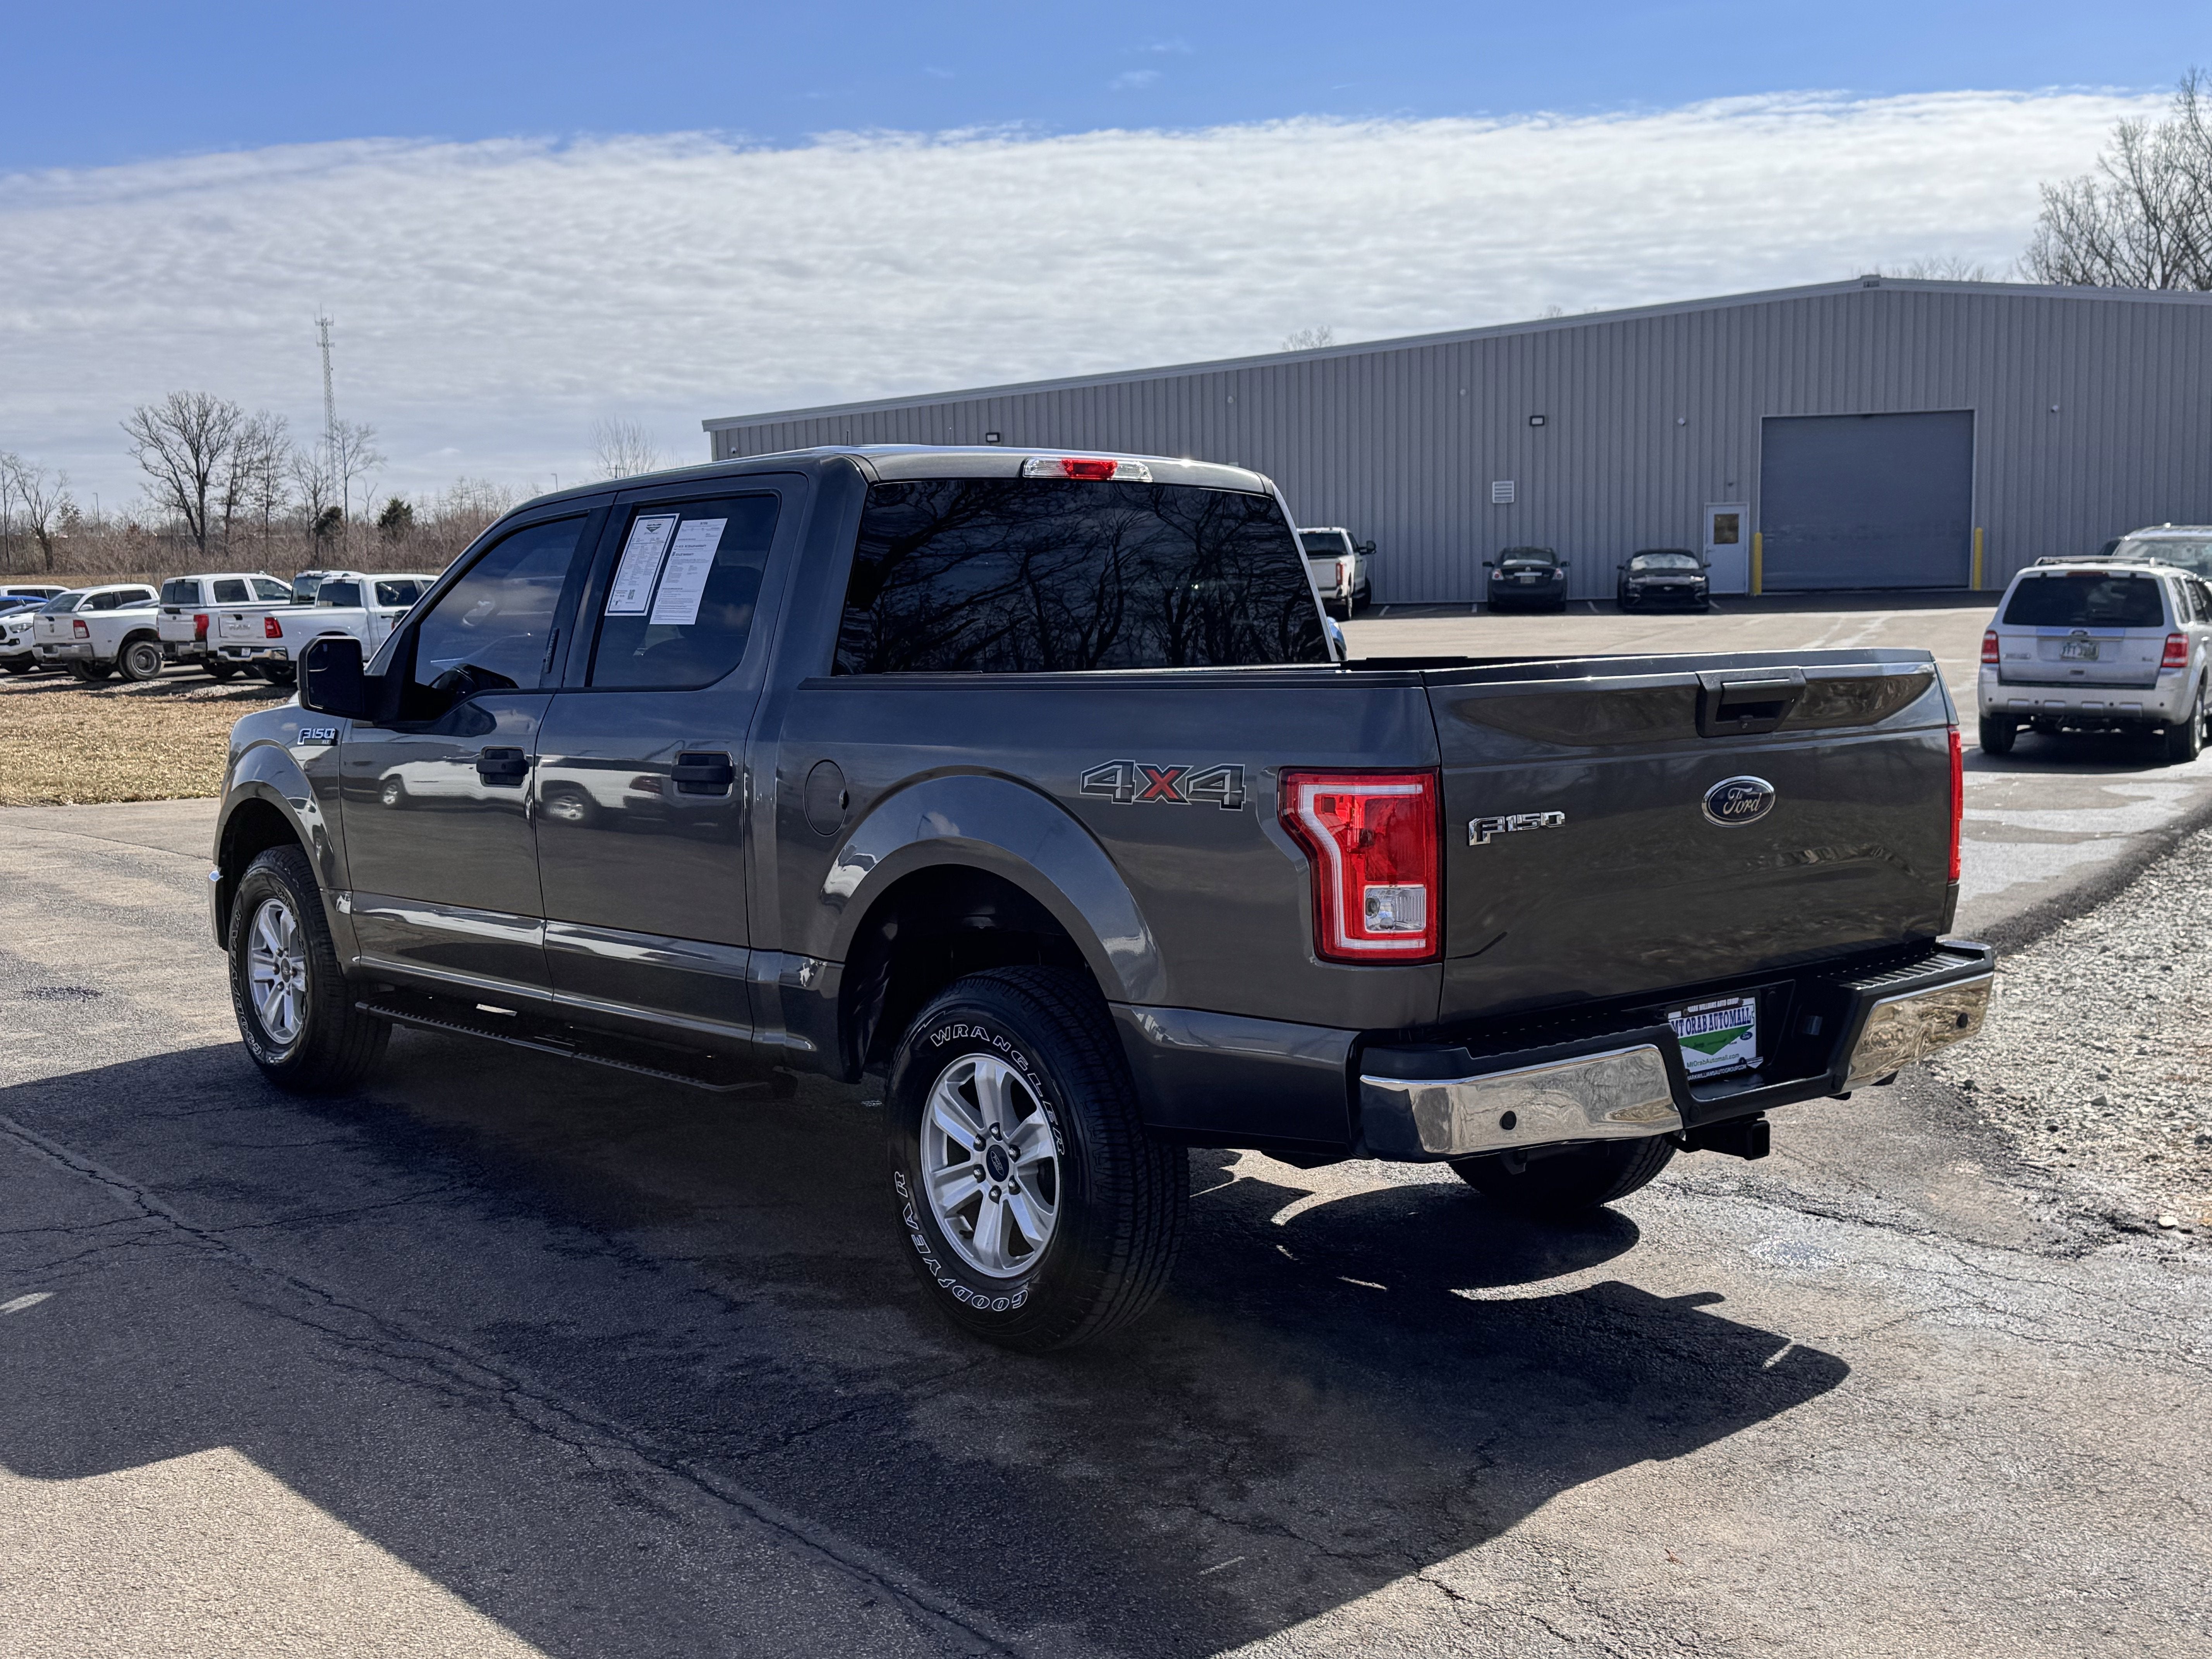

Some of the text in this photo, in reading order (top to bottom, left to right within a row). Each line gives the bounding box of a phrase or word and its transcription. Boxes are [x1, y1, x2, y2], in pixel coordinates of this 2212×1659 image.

[1723, 787, 1762, 815] Ford
[1671, 1007, 1751, 1037] MT ORAB AUTOMALL
[930, 1024, 1065, 1155] WRANGLER
[895, 1171, 1028, 1312] GOODYEAR
